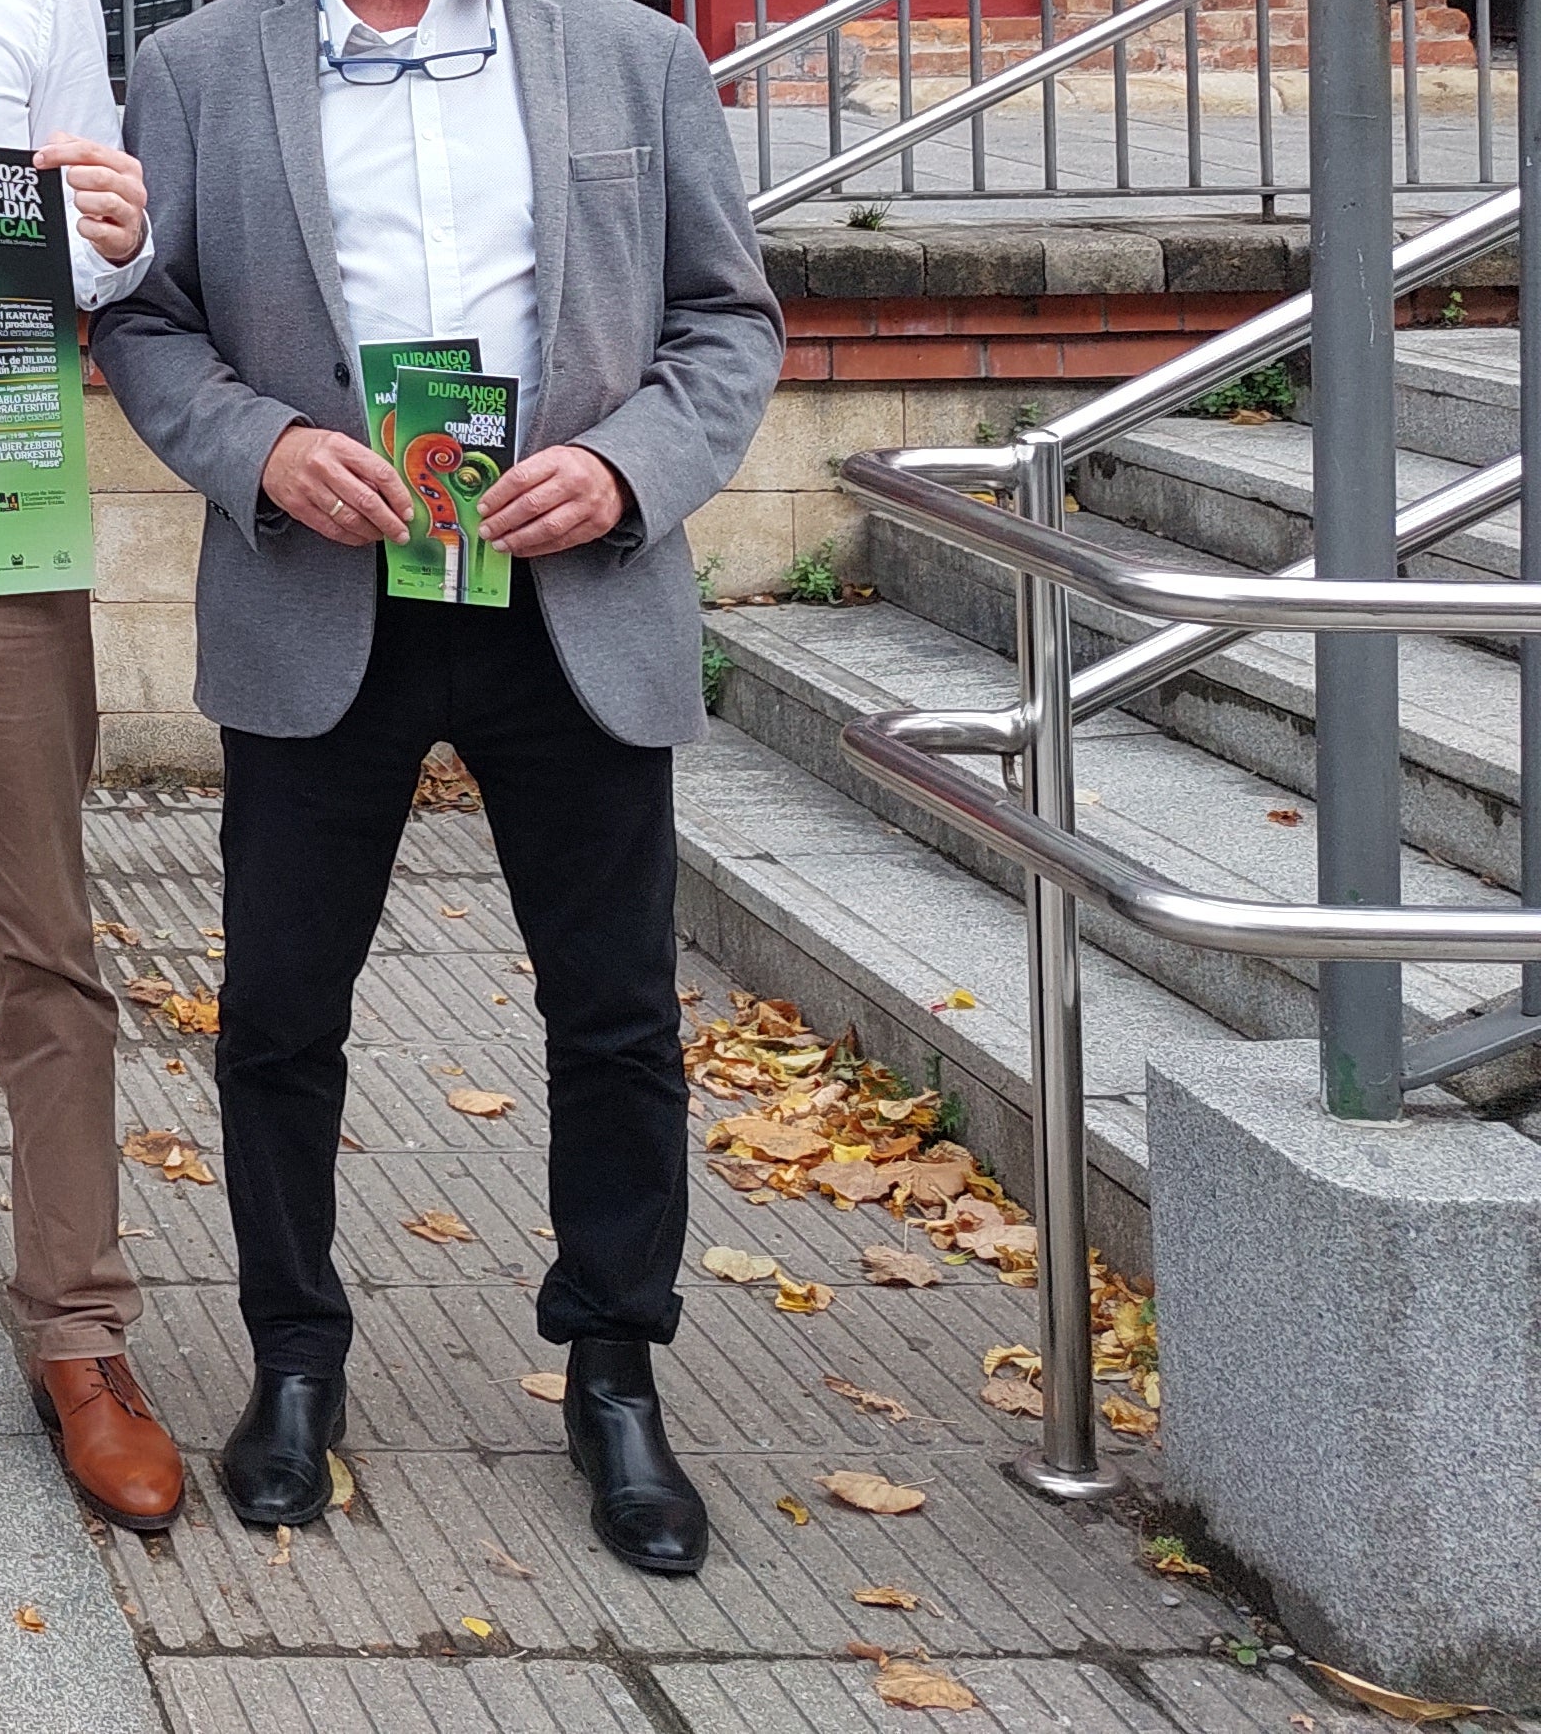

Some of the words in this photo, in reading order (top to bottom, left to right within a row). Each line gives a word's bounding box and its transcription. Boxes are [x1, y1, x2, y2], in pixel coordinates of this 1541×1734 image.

[392, 350, 470, 367] DURANGO
[428, 382, 507, 401] DURANGO
[468, 400, 505, 415] 2025
[471, 414, 505, 428] XXXVI
[445, 422, 505, 437] QUINCENA
[453, 434, 505, 448] MUSICAL
